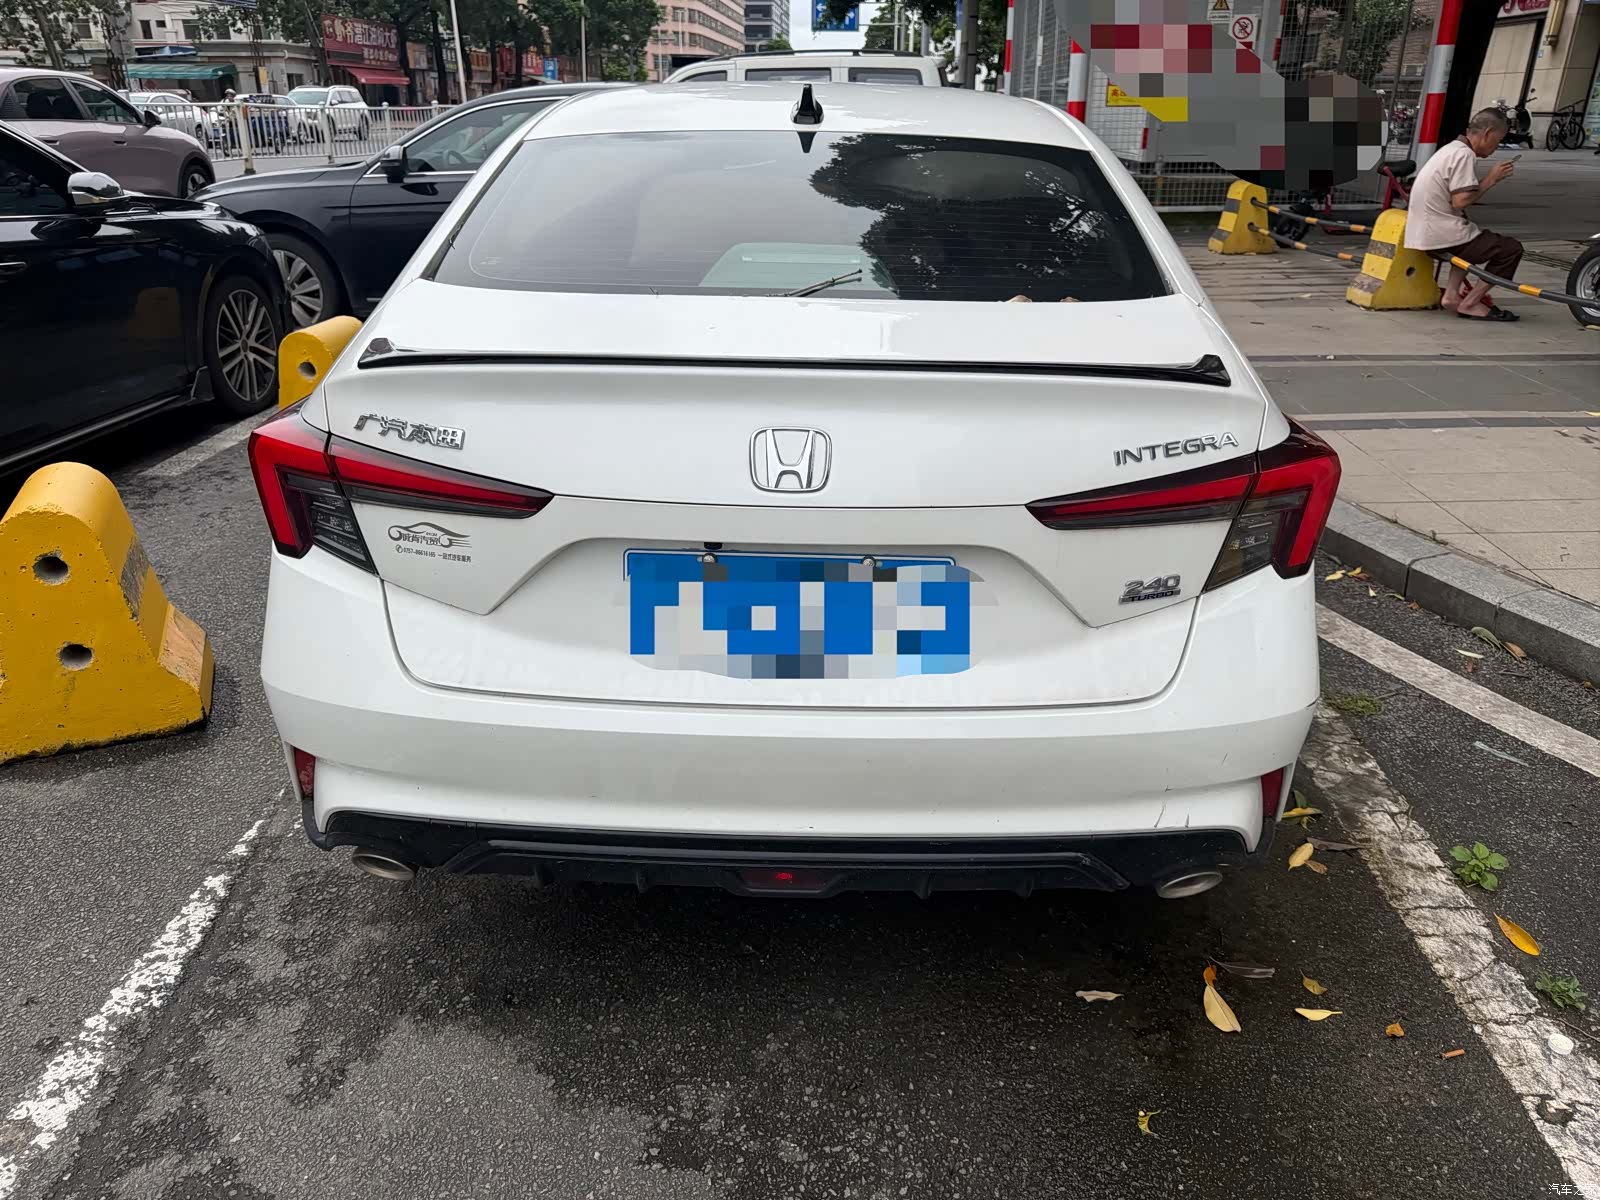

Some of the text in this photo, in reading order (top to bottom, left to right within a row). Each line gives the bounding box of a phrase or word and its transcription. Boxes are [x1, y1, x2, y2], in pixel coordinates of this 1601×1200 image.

[353, 413, 466, 450] 广汽本田
[1114, 432, 1239, 466] INTEGRA
[1124, 574, 1181, 596] 240
[1129, 590, 1174, 602] TURBO
